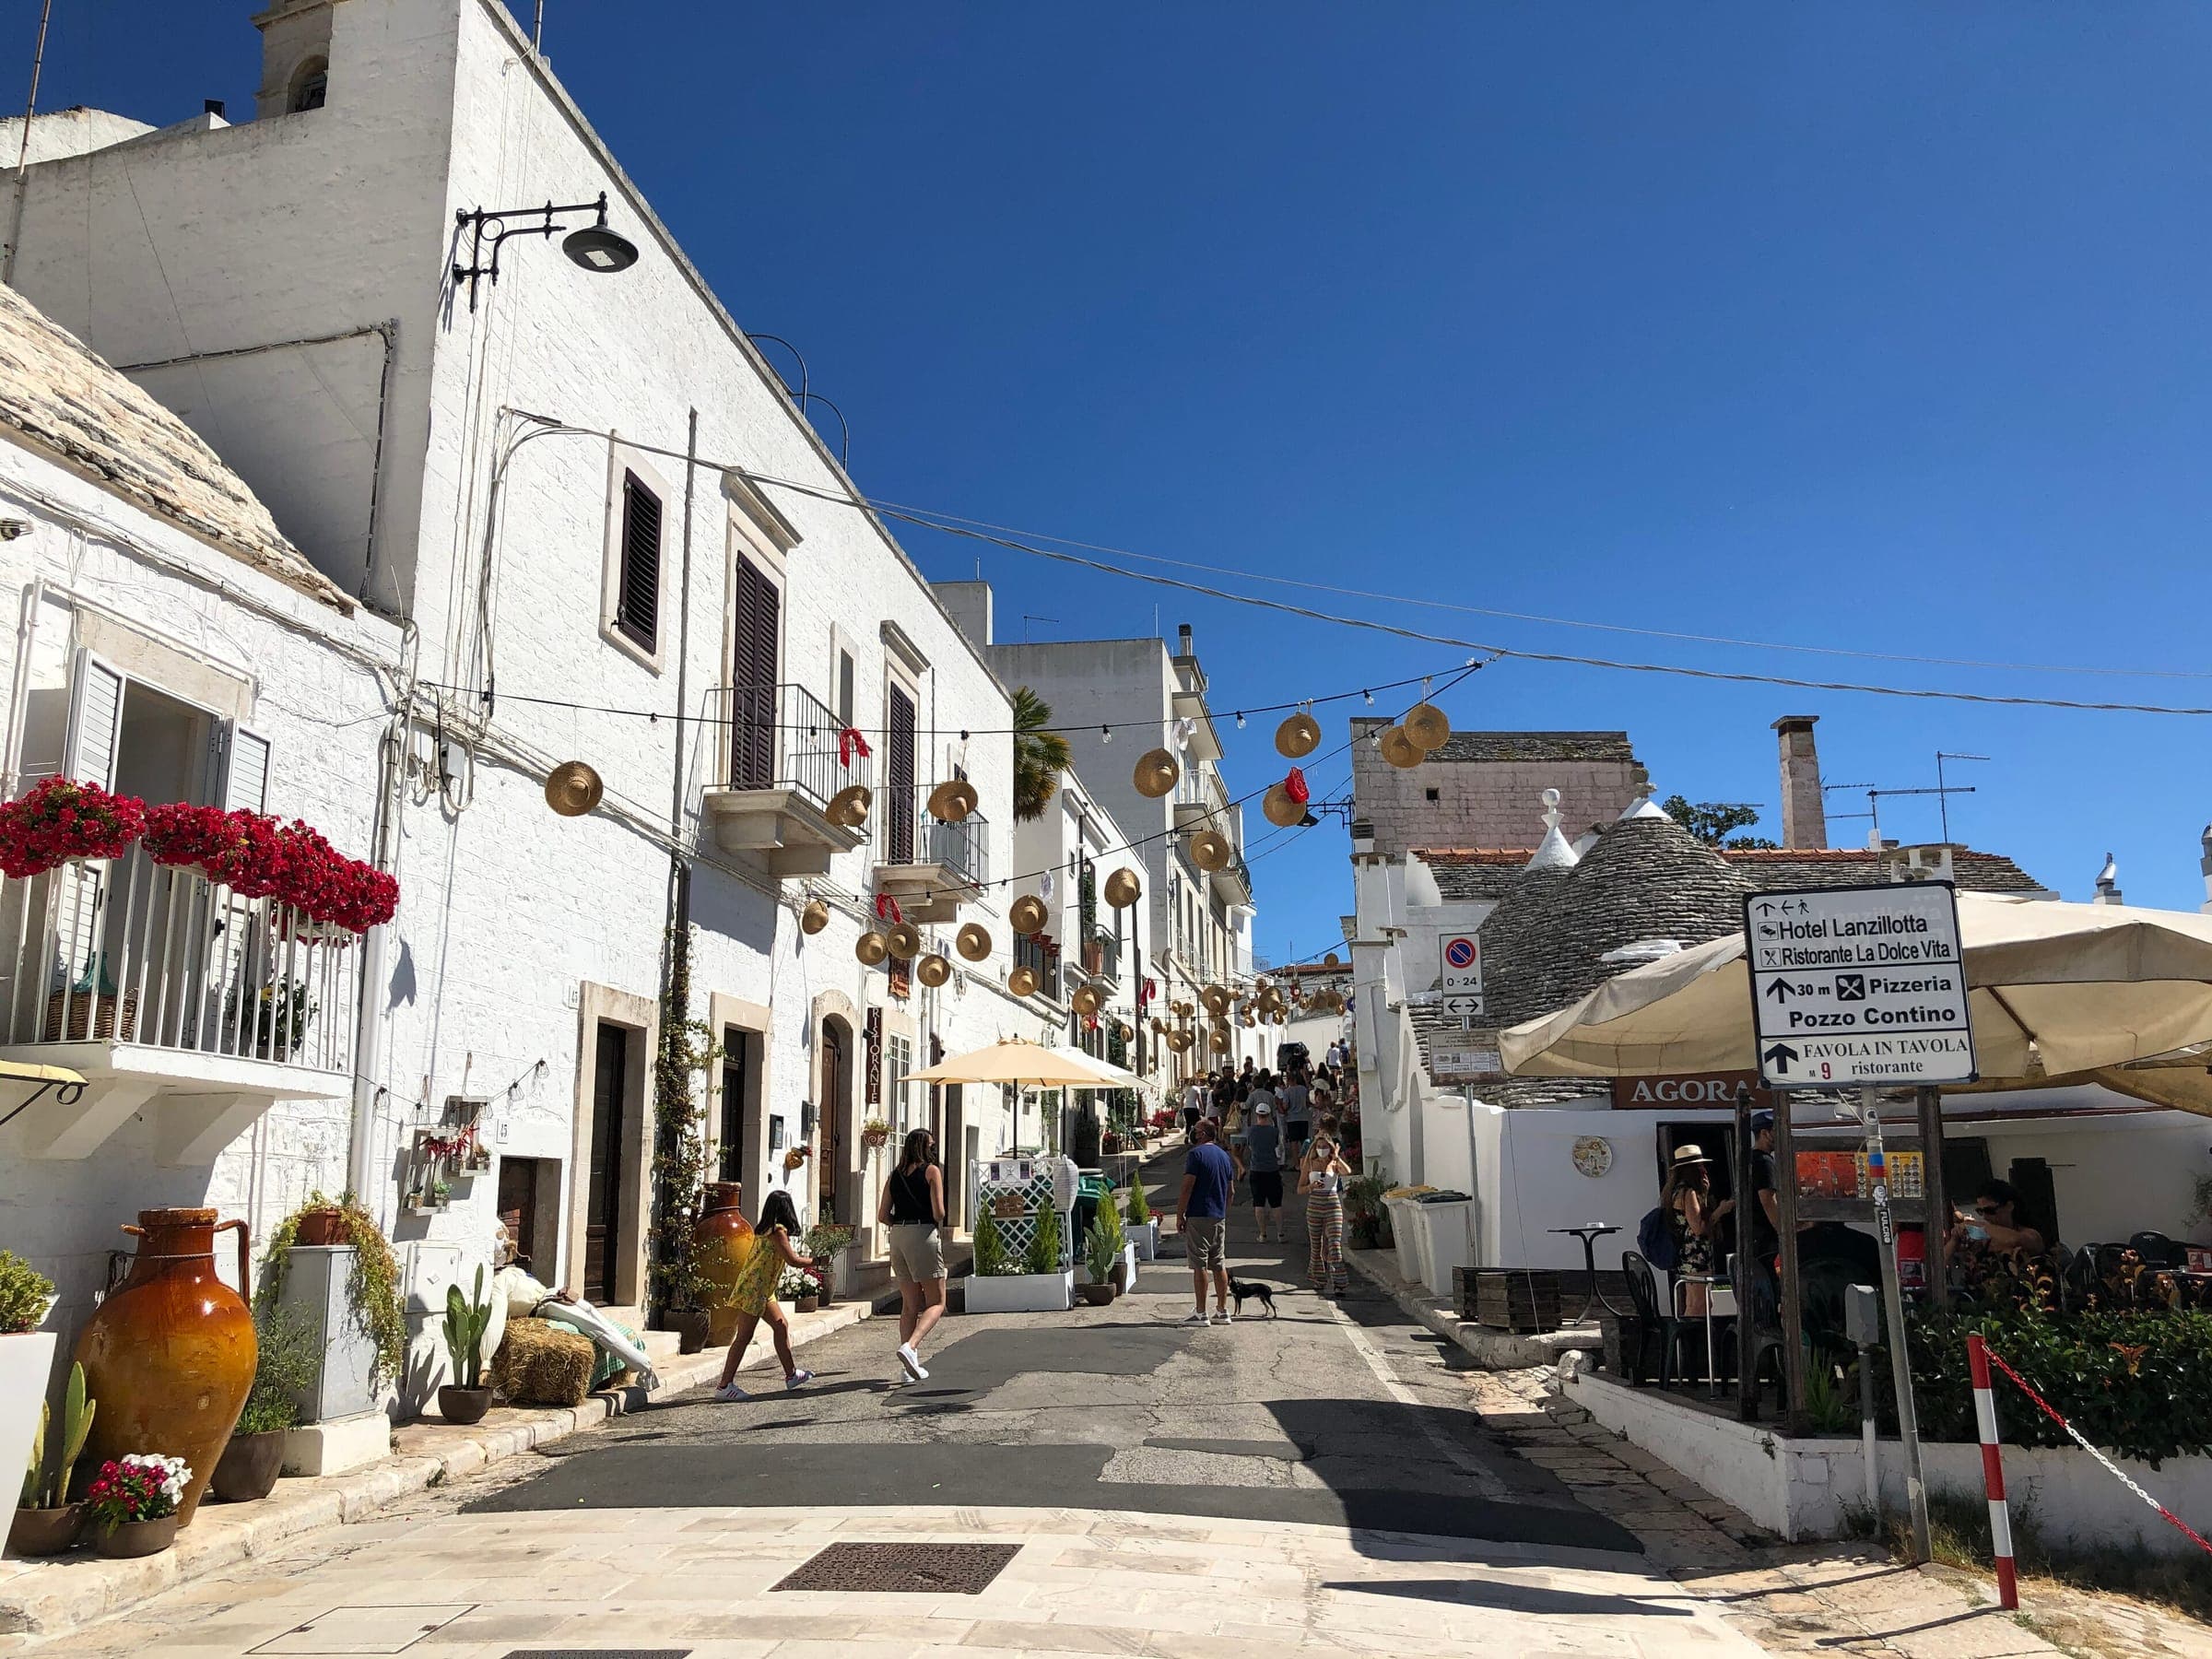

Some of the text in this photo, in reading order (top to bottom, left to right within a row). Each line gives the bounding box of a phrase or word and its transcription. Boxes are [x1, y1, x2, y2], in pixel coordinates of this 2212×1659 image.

[1779, 914, 1928, 940] Hotel Lanzillotta
[1782, 940, 1950, 966] Ristorante La Dolce Vita
[1797, 975, 1952, 996] 30 m Pizzeria
[1789, 1006, 1956, 1028] Pozzo Contino
[870, 1007, 880, 1102] RISTORANTE
[1804, 1038, 1968, 1058] FAVOLA IN TAVOLA
[1821, 1062, 1830, 1079] 9
[1851, 1060, 1924, 1076] ristorante
[1880, 1211, 1890, 1242] FULCRO
